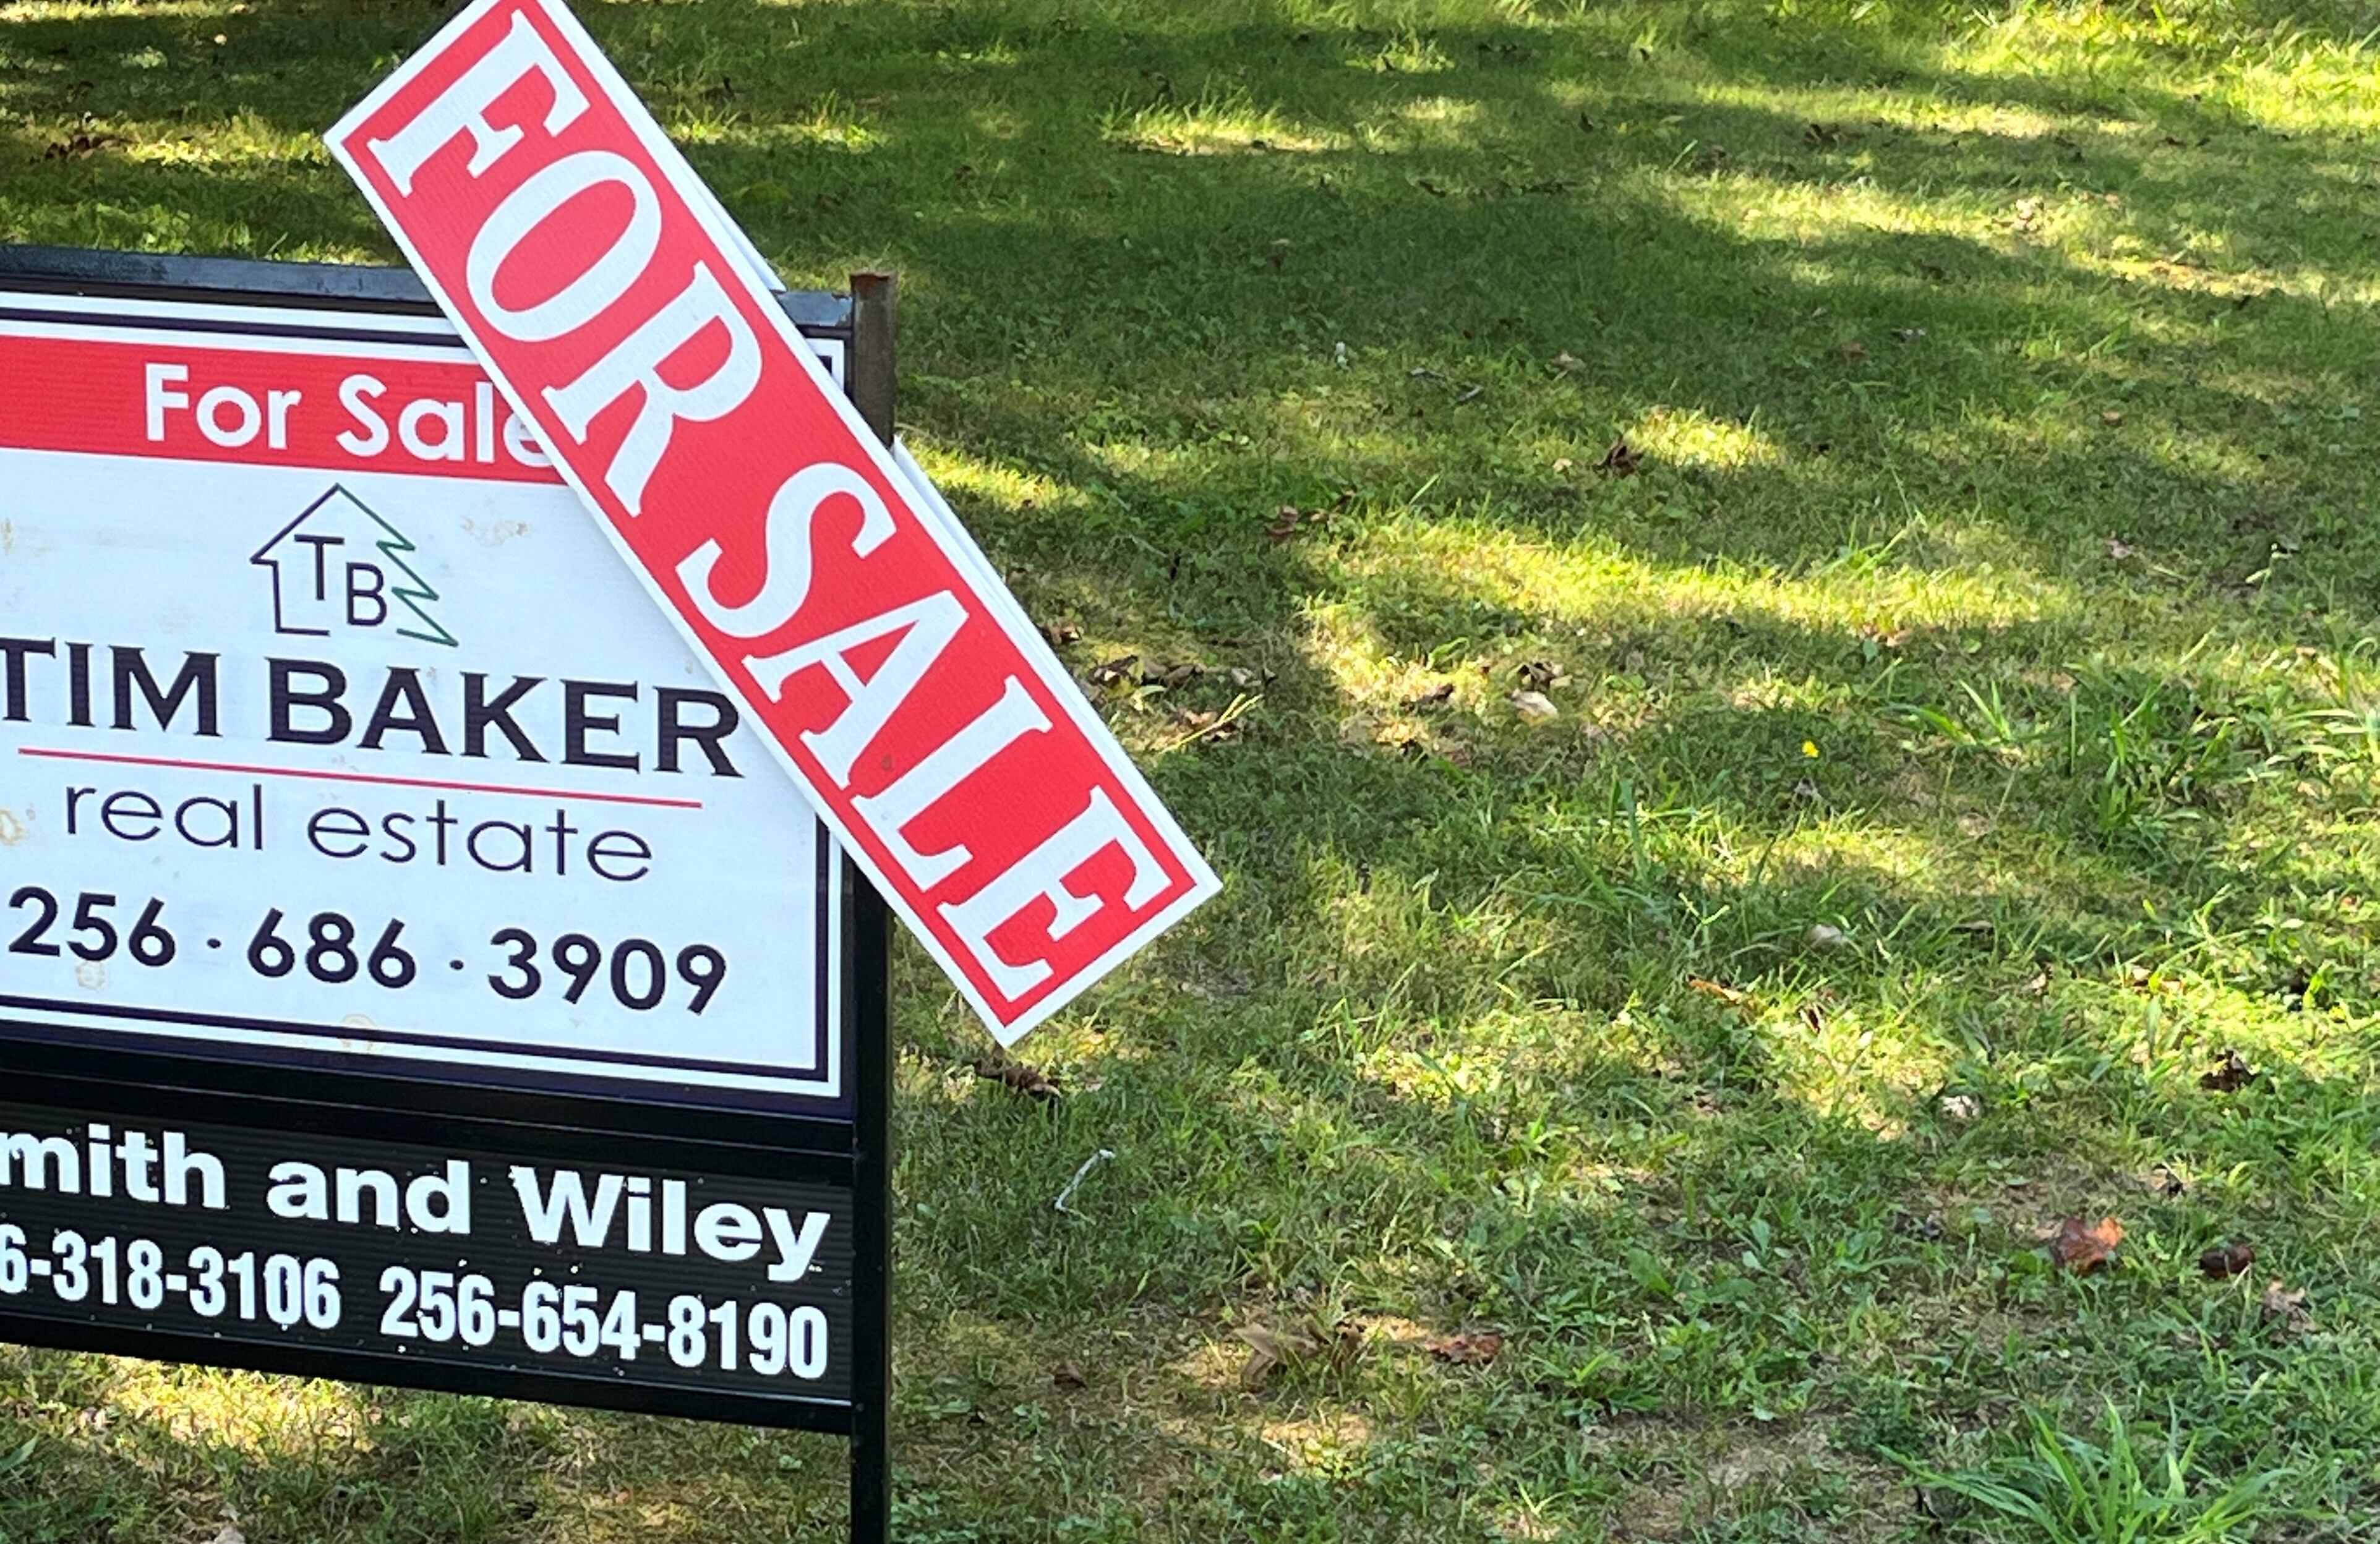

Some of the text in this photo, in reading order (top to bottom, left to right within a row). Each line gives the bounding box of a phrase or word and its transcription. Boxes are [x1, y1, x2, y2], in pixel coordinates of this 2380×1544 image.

[145, 363, 302, 450] For
[368, 9, 1172, 1003] FOR SALE
[0, 638, 745, 777] TIM BAKER
[66, 783, 653, 881] real estate
[266, 1159, 471, 1235] and
[510, 1165, 831, 1281] Wiley
[0, 1222, 828, 1380] 6-318-3106 256-654-8190
